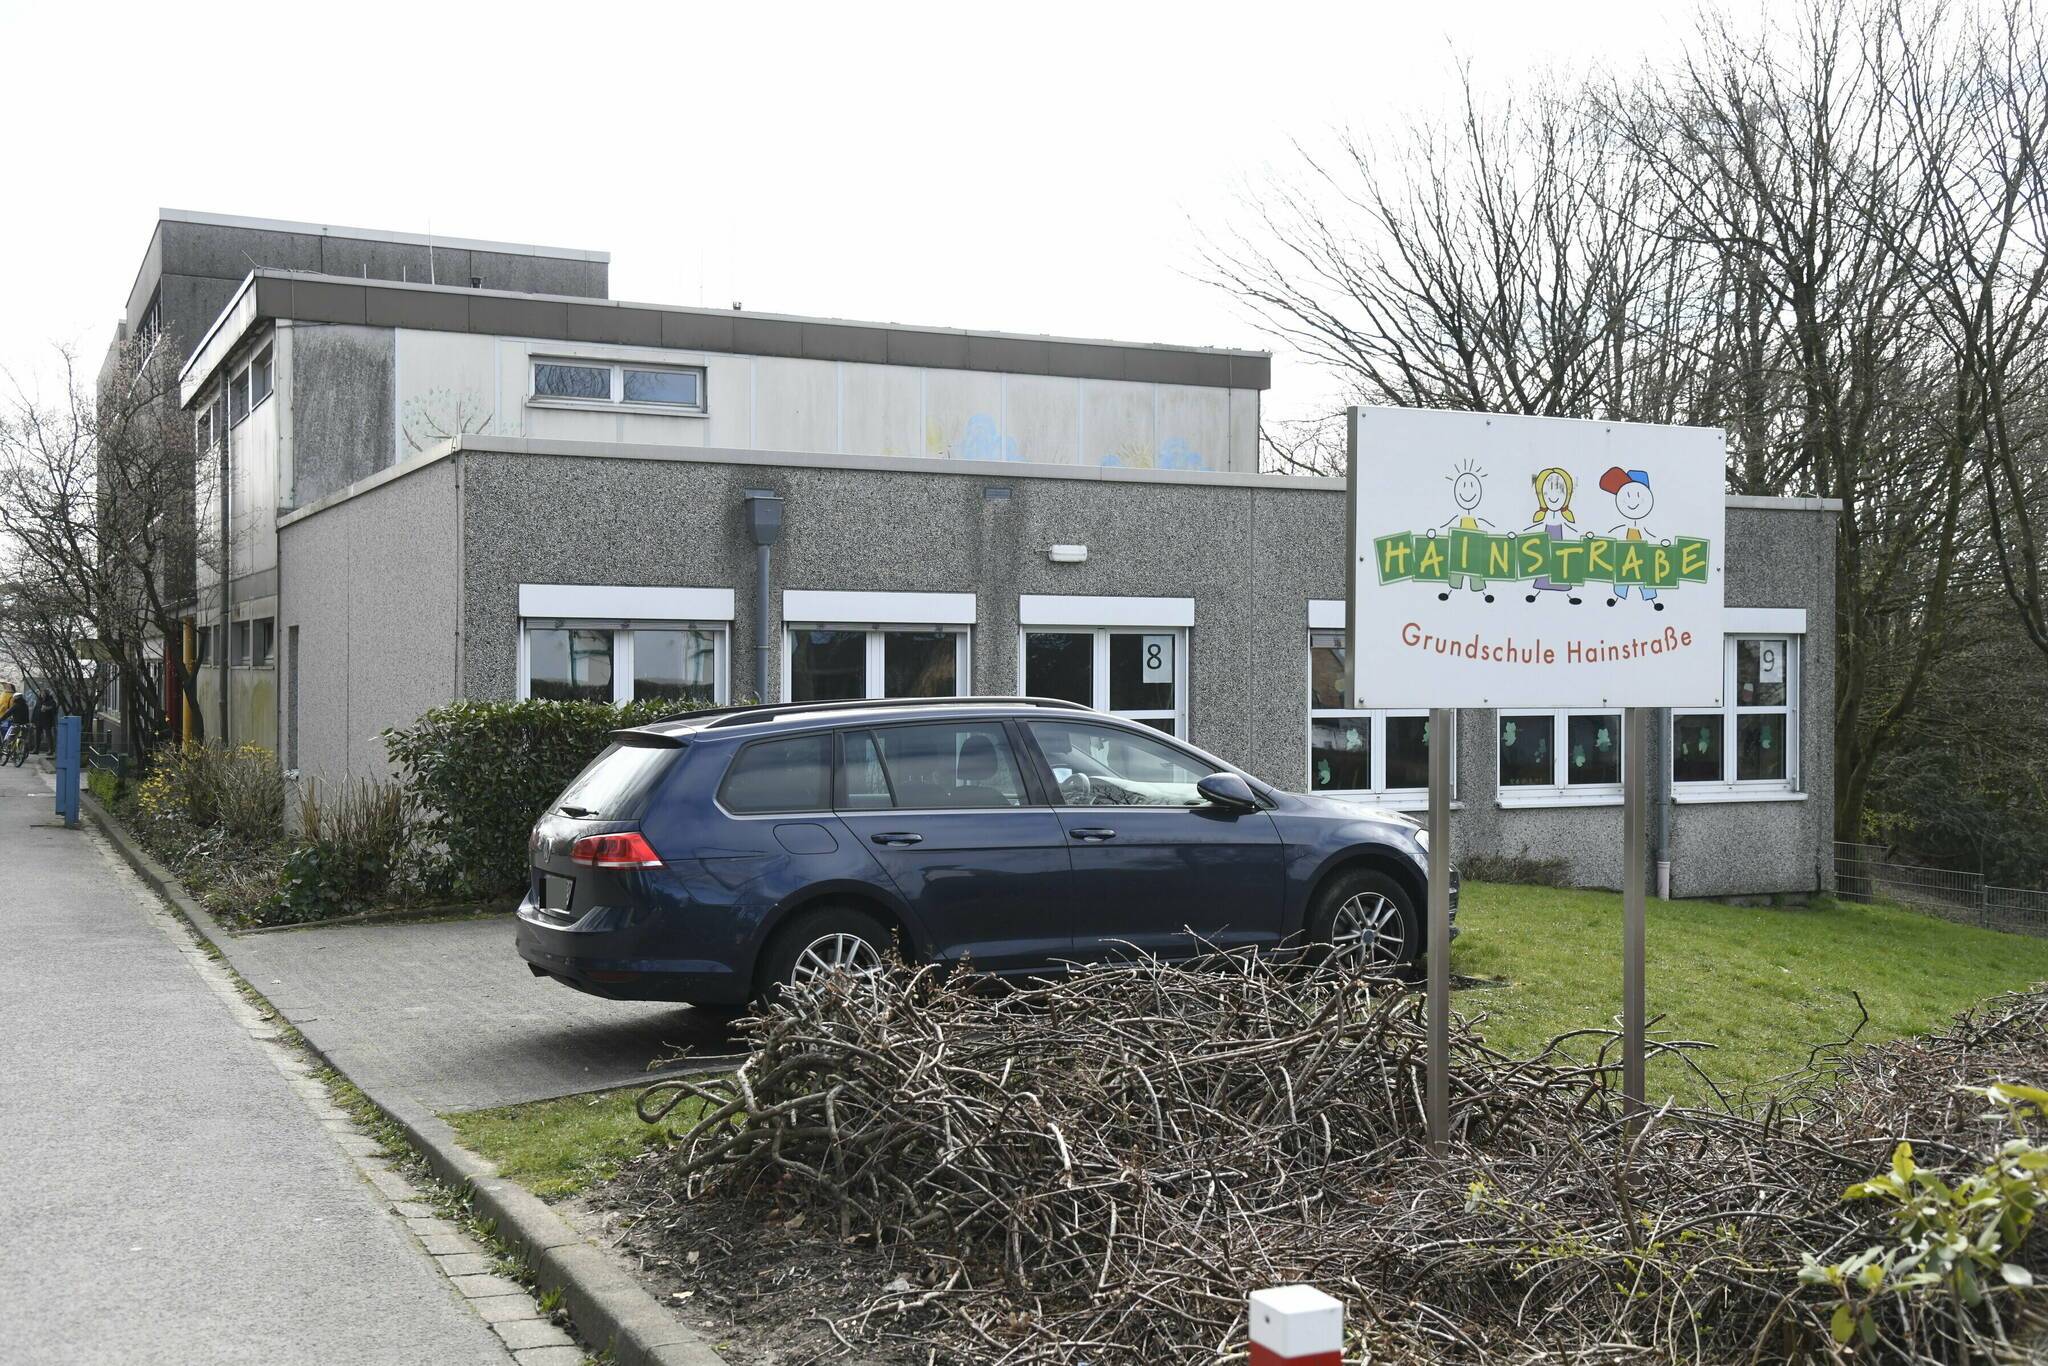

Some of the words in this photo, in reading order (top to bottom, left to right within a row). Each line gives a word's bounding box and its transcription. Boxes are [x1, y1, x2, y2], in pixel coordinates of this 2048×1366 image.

[1146, 643, 1162, 670] 8
[1401, 622, 1556, 664] Grundschule
[1566, 625, 1693, 664] Hainstraße
[1763, 649, 1775, 673] 9
